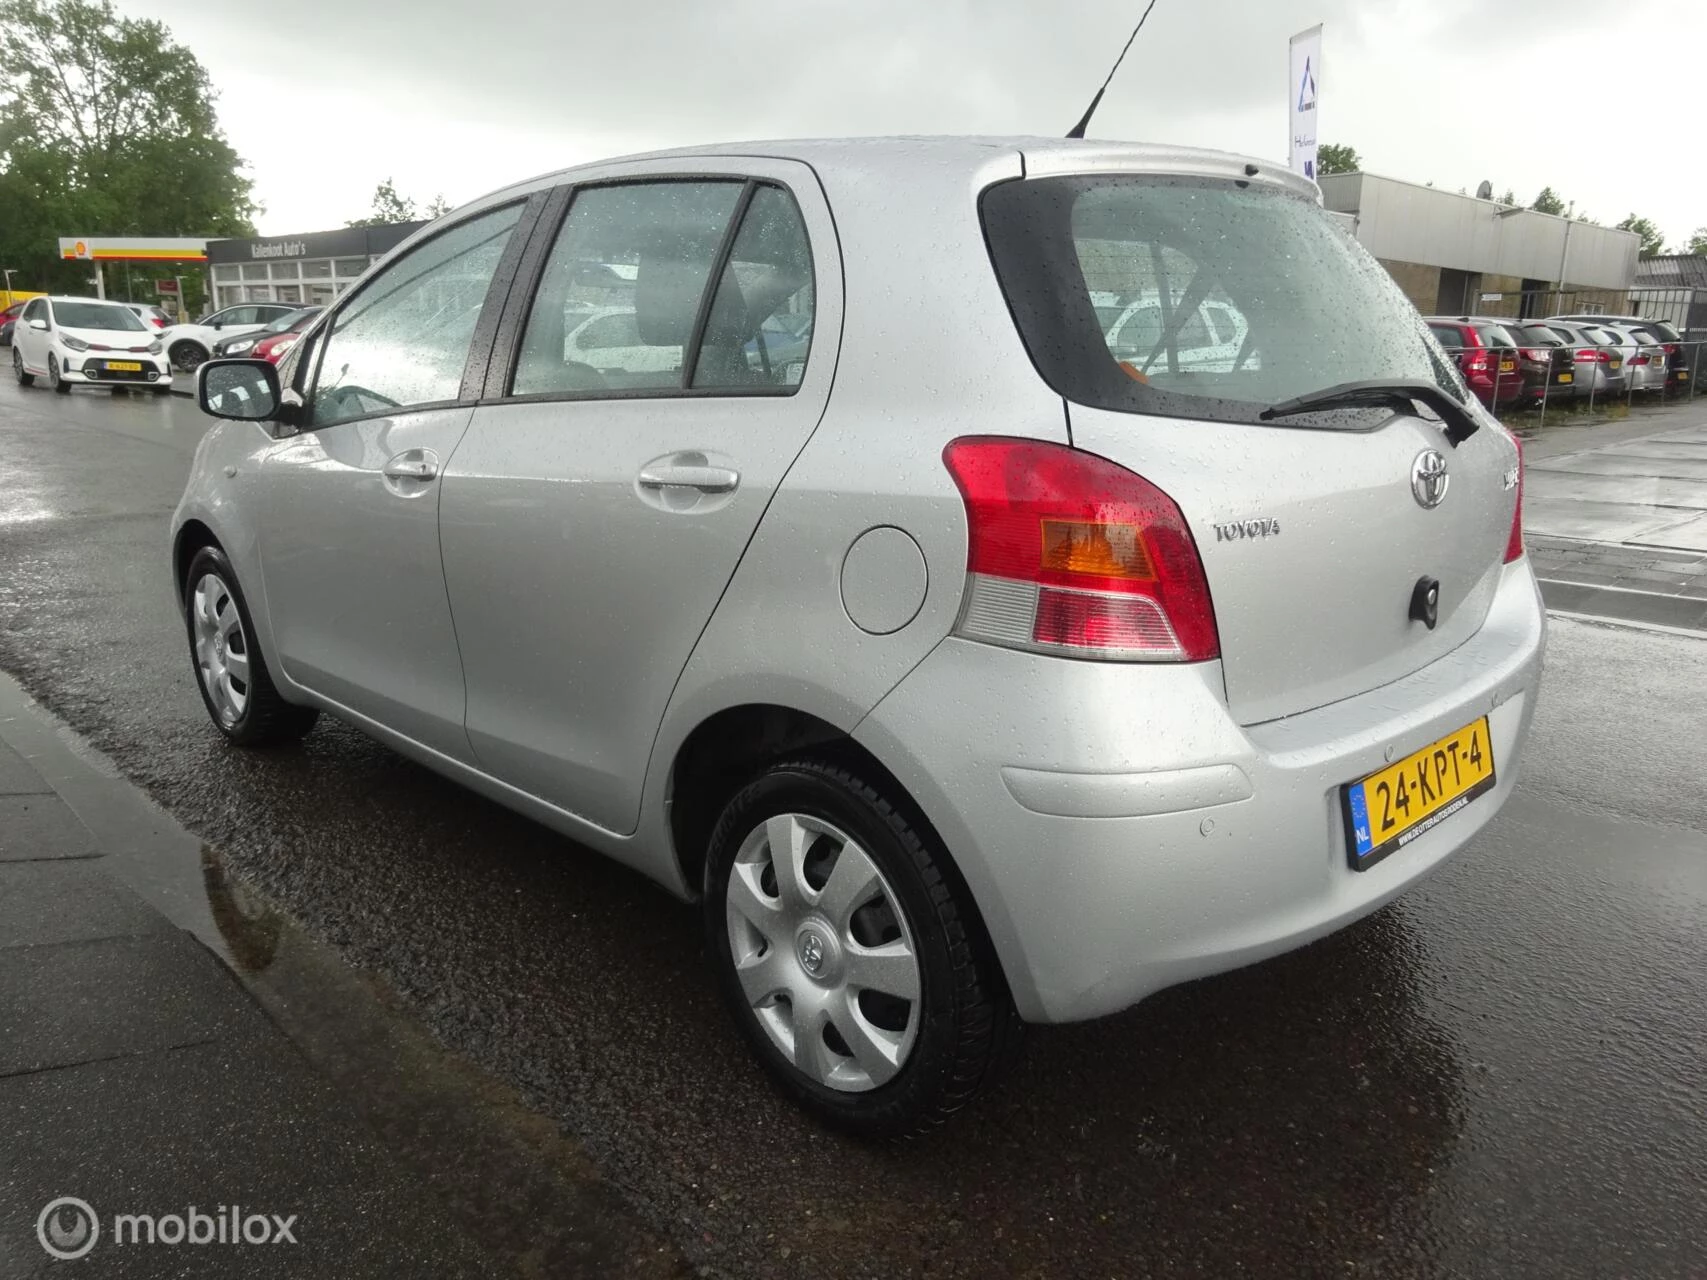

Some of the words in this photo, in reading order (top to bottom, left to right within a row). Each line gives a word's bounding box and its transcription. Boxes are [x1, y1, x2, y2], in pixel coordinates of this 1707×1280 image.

[284, 240, 306, 257] Auto's
[1213, 517, 1280, 541] TOYOTA
[1376, 730, 1482, 832] 24-KPT-4
[1356, 829, 1369, 845] NL
